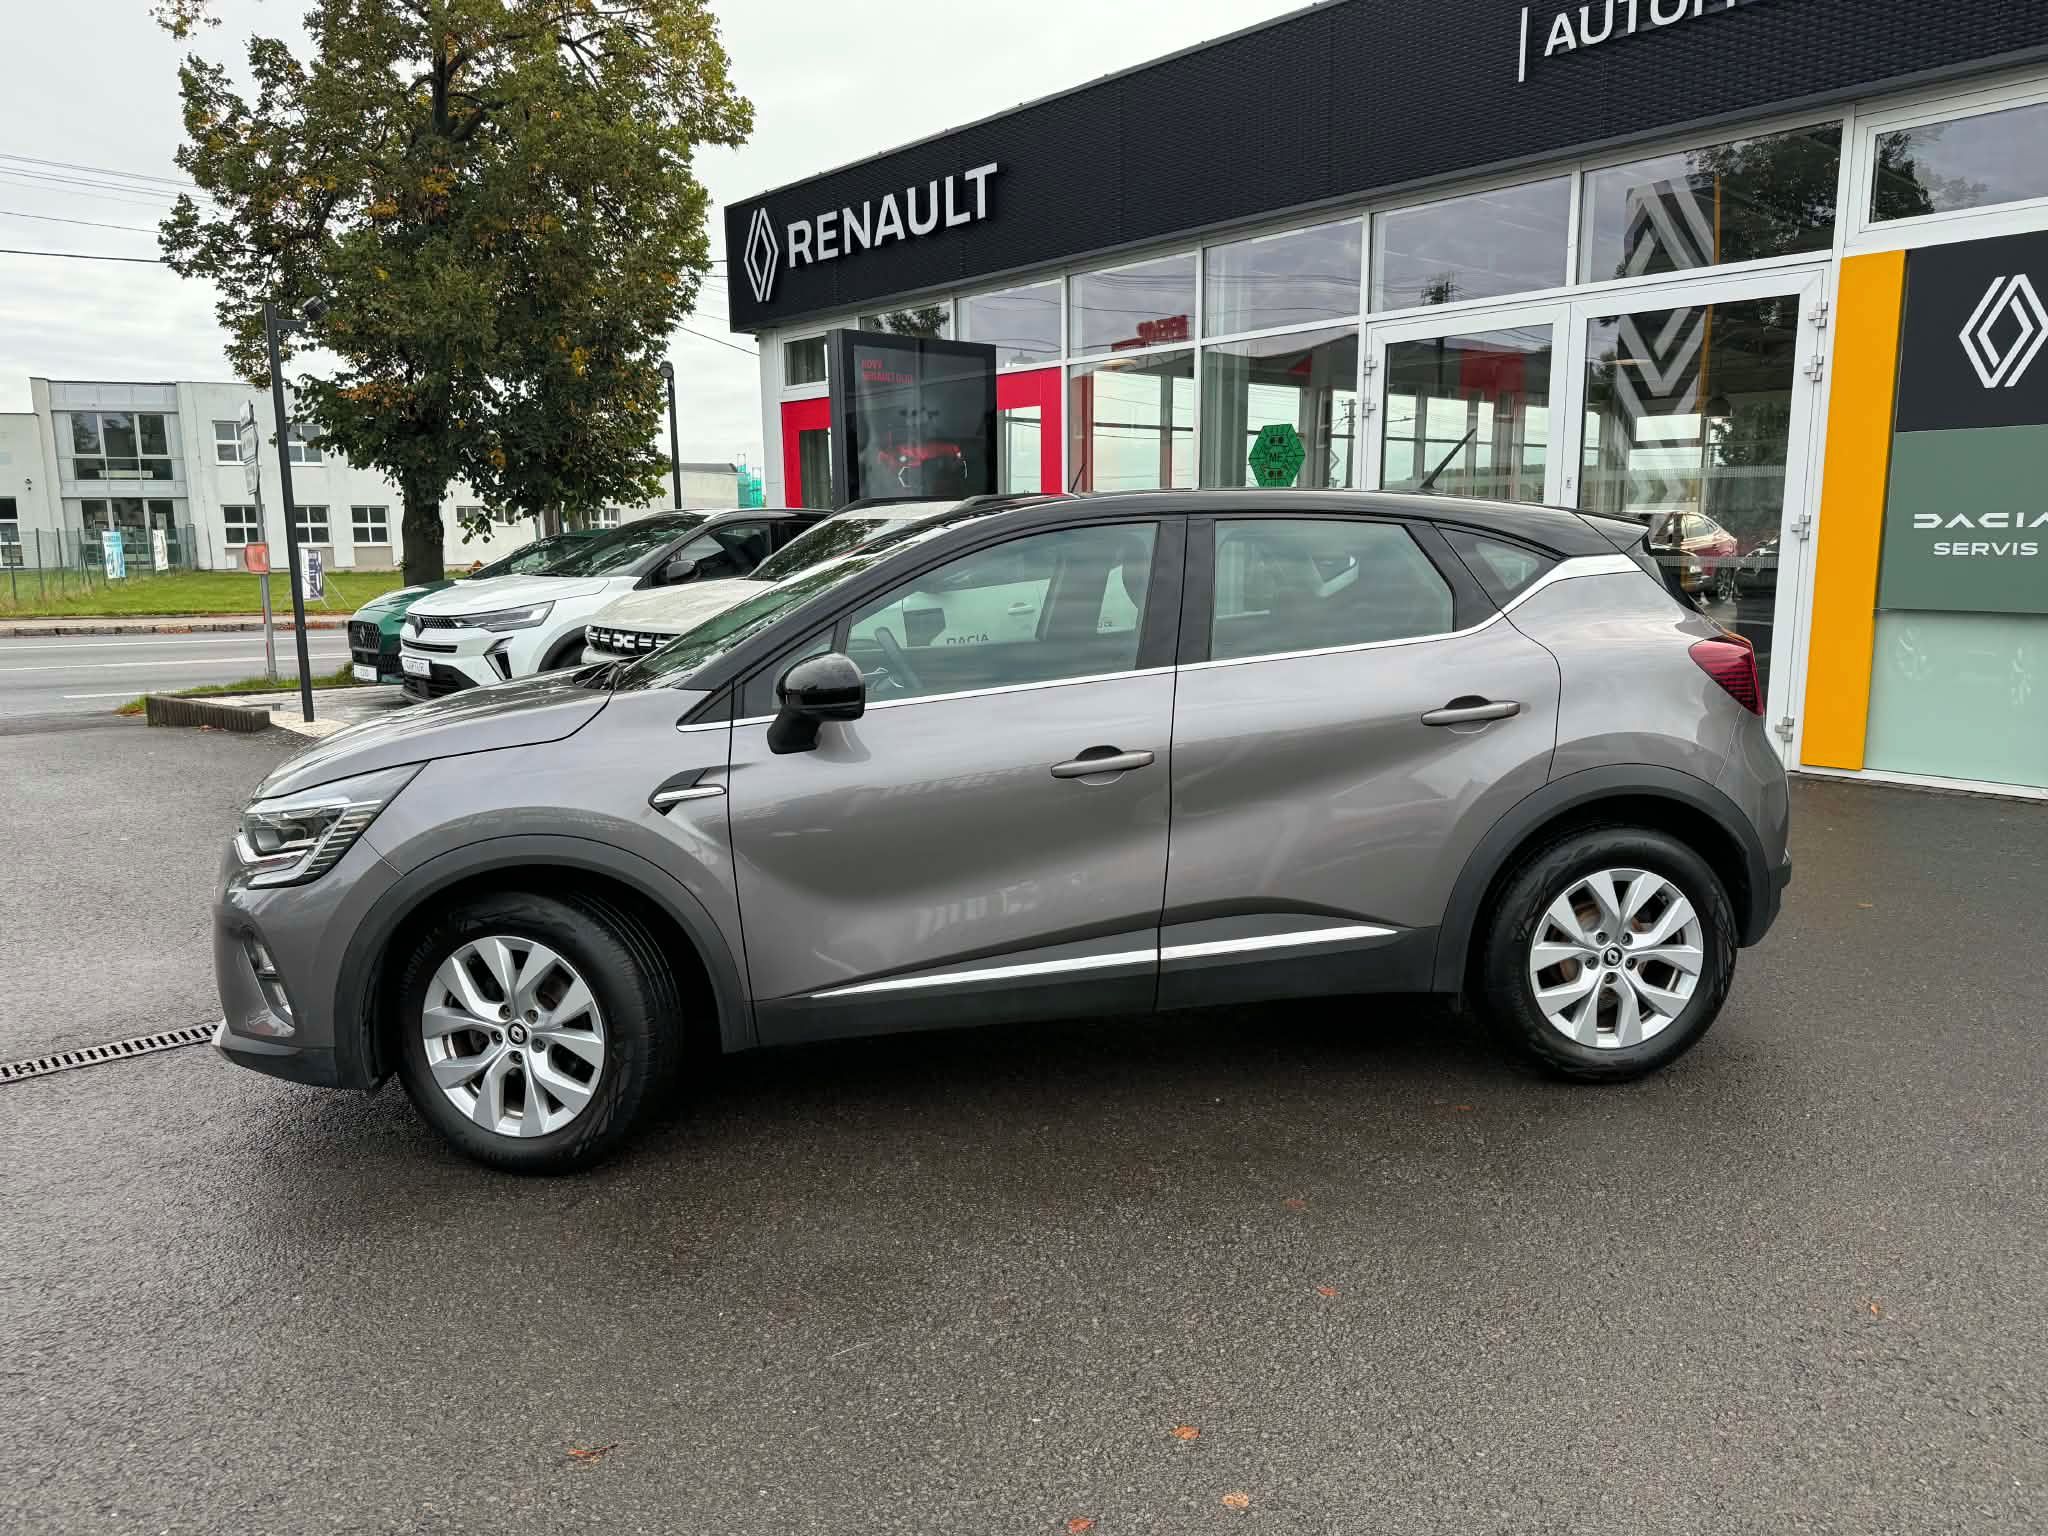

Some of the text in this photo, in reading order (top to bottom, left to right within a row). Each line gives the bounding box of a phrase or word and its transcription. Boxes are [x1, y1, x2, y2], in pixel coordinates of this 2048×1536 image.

[787, 161, 998, 268] RENAULT
[1913, 512, 2048, 529] DACIA
[1933, 542, 2039, 556] SERVIS
